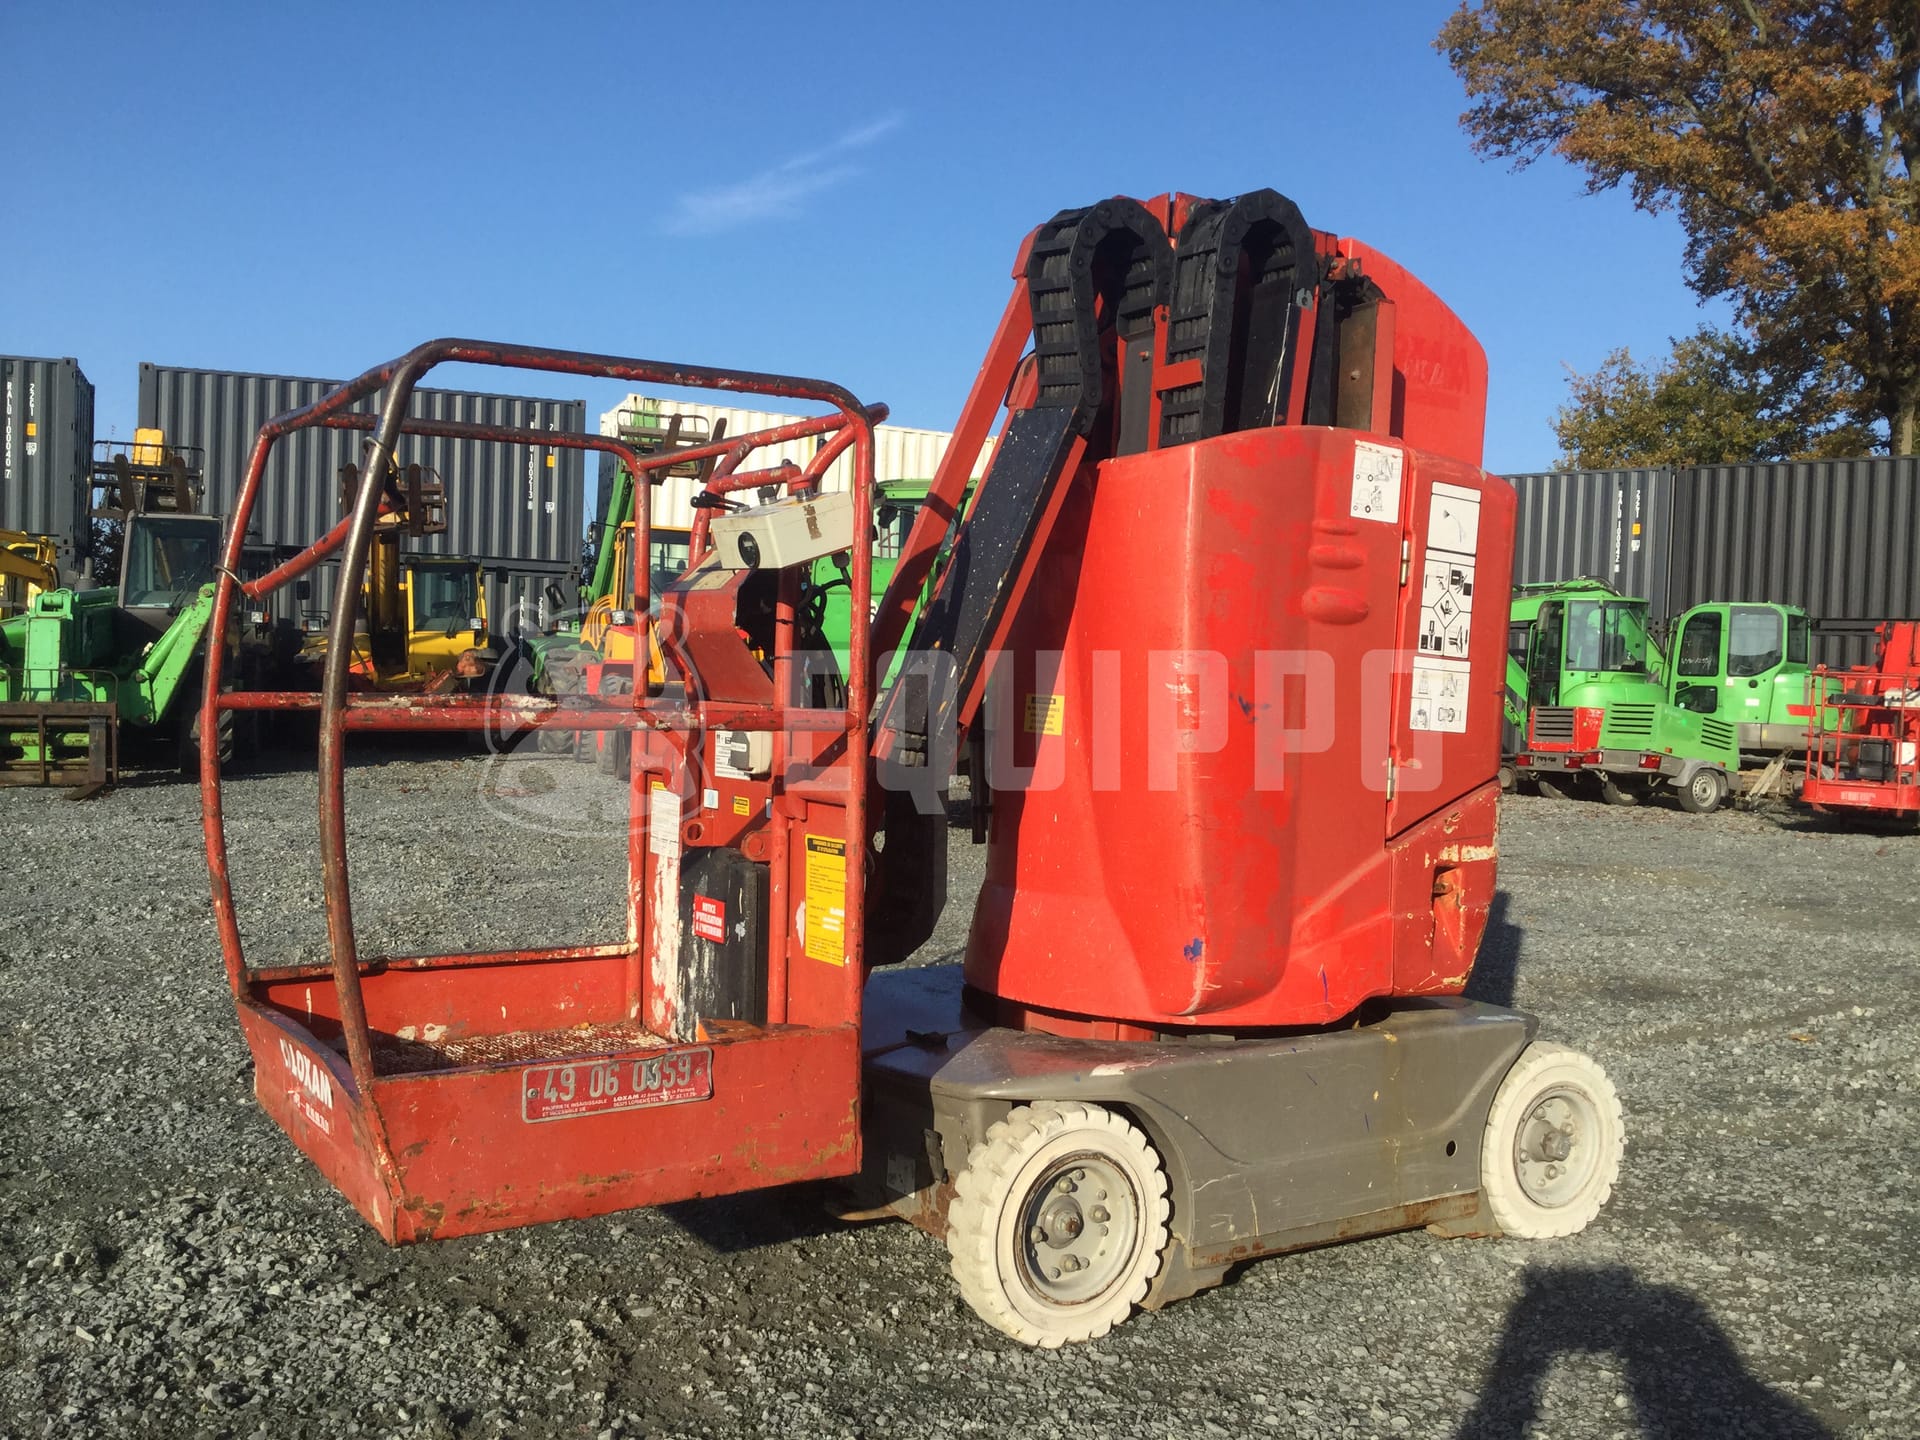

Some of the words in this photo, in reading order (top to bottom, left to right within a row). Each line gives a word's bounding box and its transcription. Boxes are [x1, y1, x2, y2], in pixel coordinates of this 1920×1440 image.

[288, 1042, 333, 1111] LOXAM
[543, 1068, 576, 1102] 49
[588, 1062, 620, 1098] 06
[632, 1054, 692, 1093] 0359
[613, 1093, 640, 1102] LOXAM
